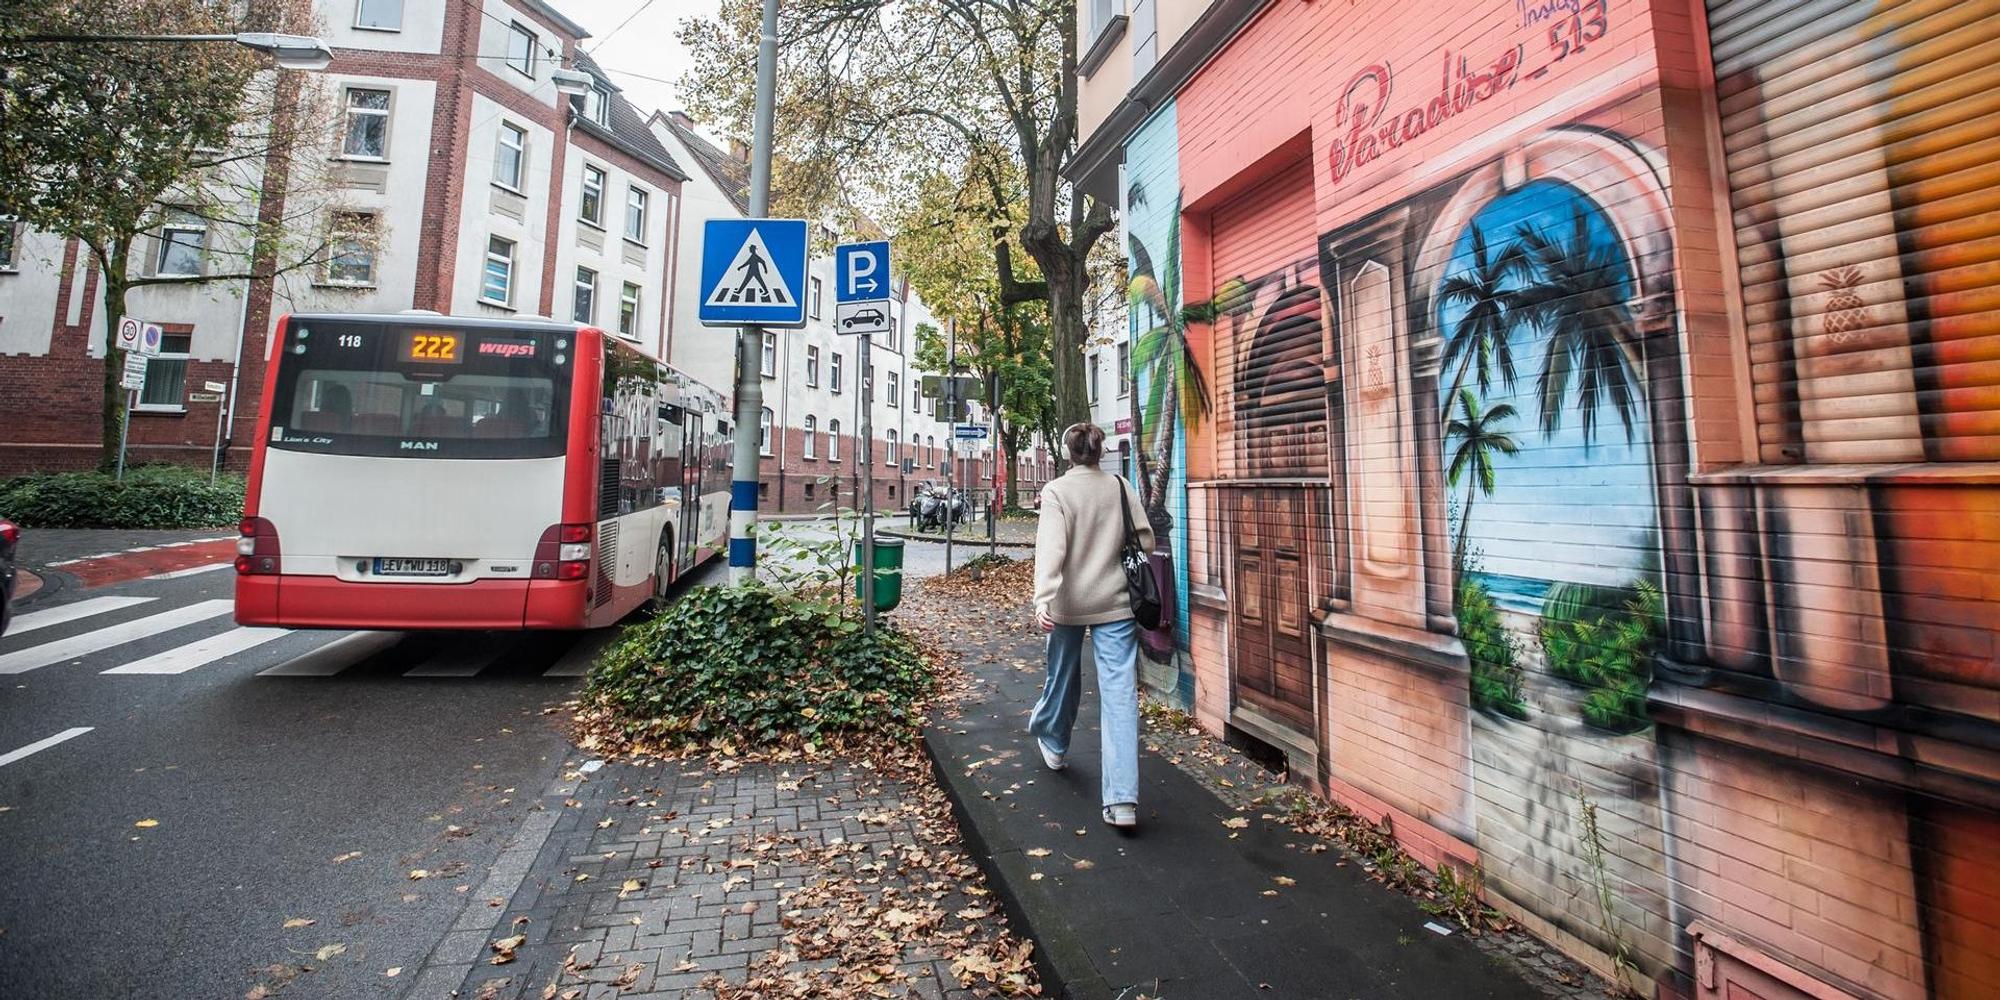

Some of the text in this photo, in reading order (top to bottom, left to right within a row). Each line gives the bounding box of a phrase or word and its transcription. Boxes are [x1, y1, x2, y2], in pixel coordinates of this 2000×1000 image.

[848, 250, 877, 295] P
[125, 325, 135, 337] 30
[338, 334, 362, 348] 118
[411, 335, 456, 359] 222
[479, 340, 535, 357] wupsi
[400, 440, 438, 450] MAN
[426, 560, 447, 571] 118
